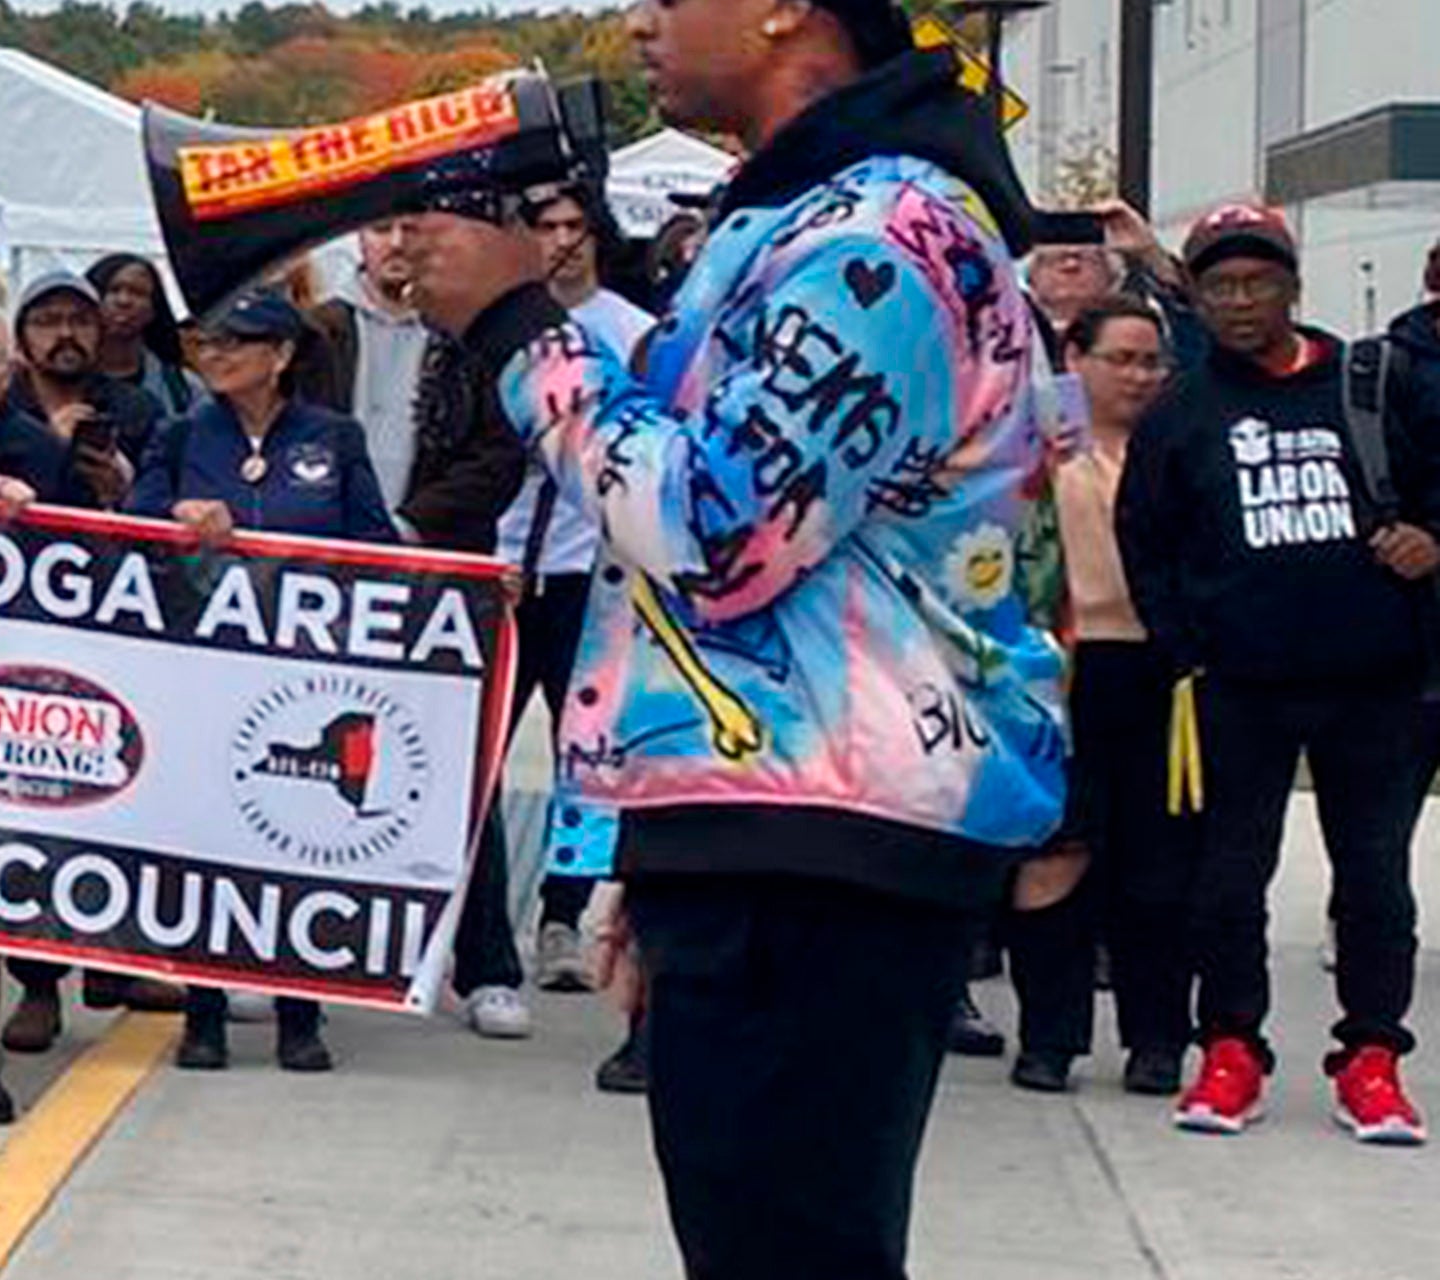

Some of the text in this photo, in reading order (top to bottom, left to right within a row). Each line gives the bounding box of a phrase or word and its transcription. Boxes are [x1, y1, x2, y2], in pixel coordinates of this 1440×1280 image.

[292, 127, 376, 170] THE
[1239, 460, 1349, 507] LABOR
[1244, 501, 1356, 548] UNION
[195, 565, 484, 668] AREA
